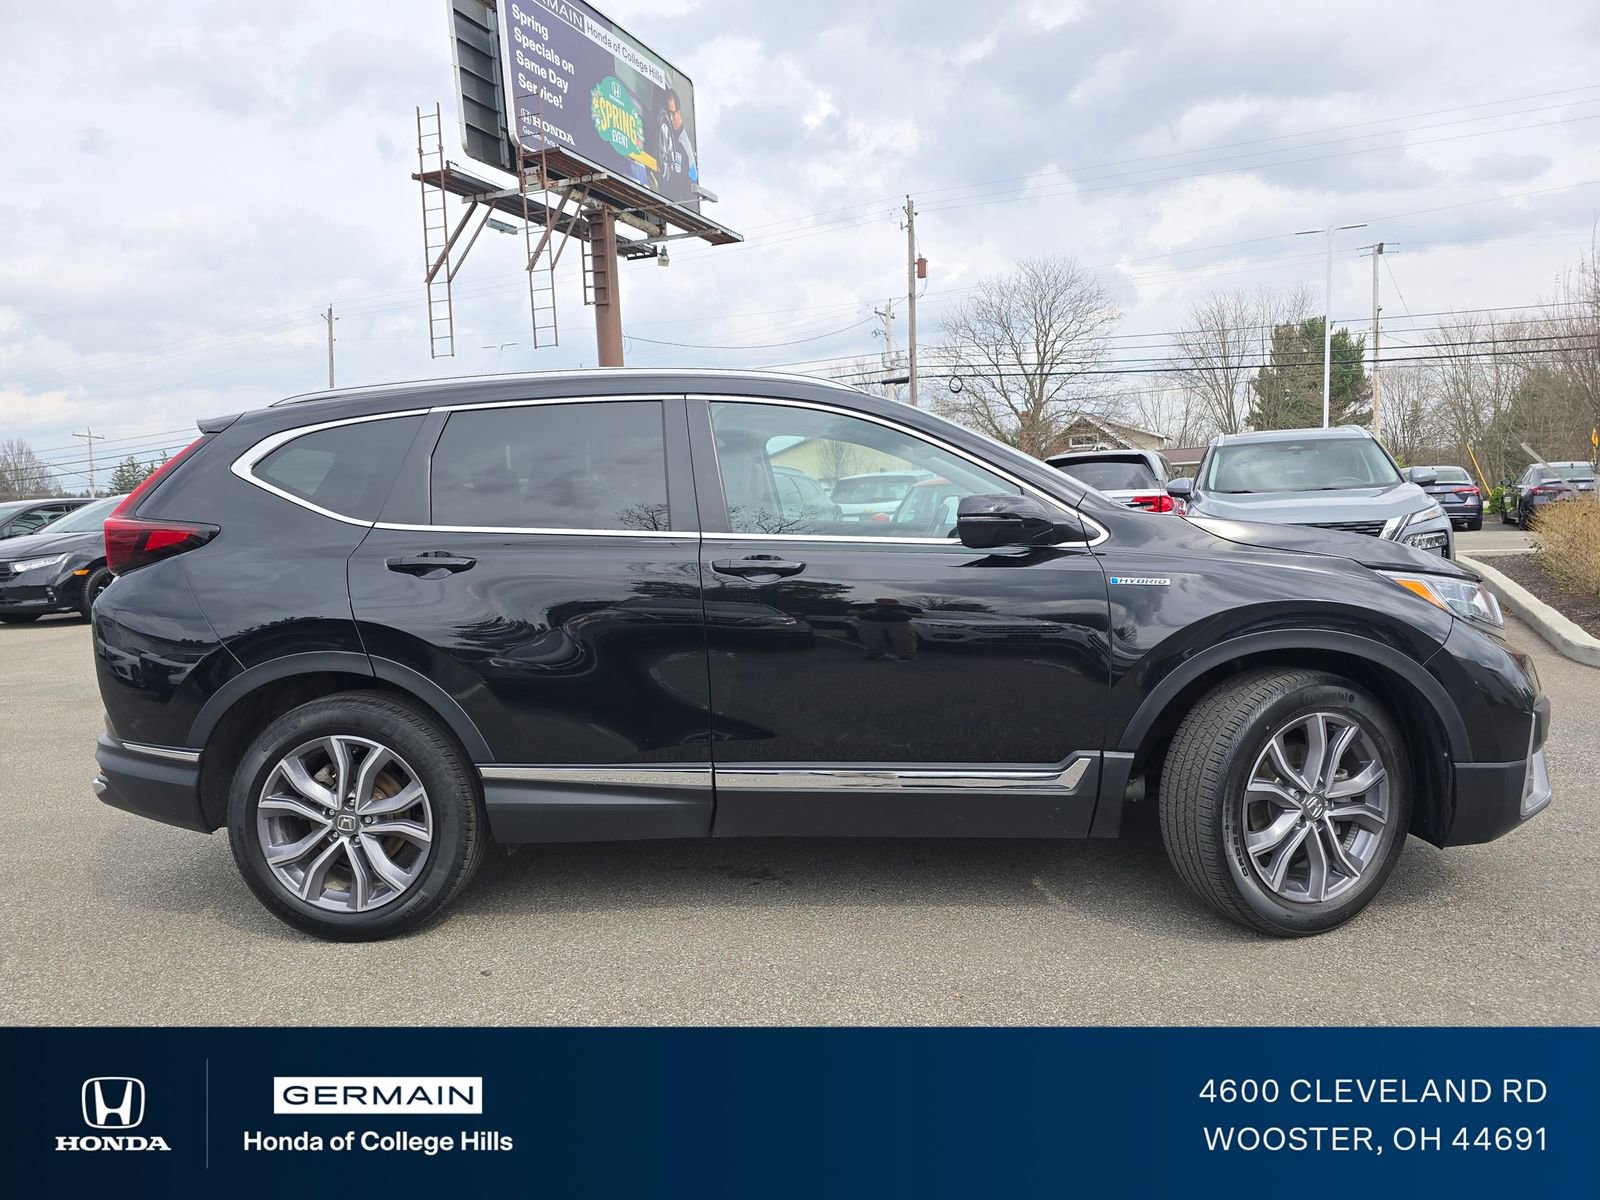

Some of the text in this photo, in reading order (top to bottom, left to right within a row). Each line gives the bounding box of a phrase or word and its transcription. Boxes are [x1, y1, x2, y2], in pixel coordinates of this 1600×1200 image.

[511, 3, 548, 41] Spring
[513, 26, 575, 75] Specials on
[516, 50, 568, 94] Same Day
[586, 21, 664, 83] Honda of College Hills
[532, 115, 576, 146] HONDA
[599, 97, 637, 146] SPRING
[612, 129, 628, 149] EVENT
